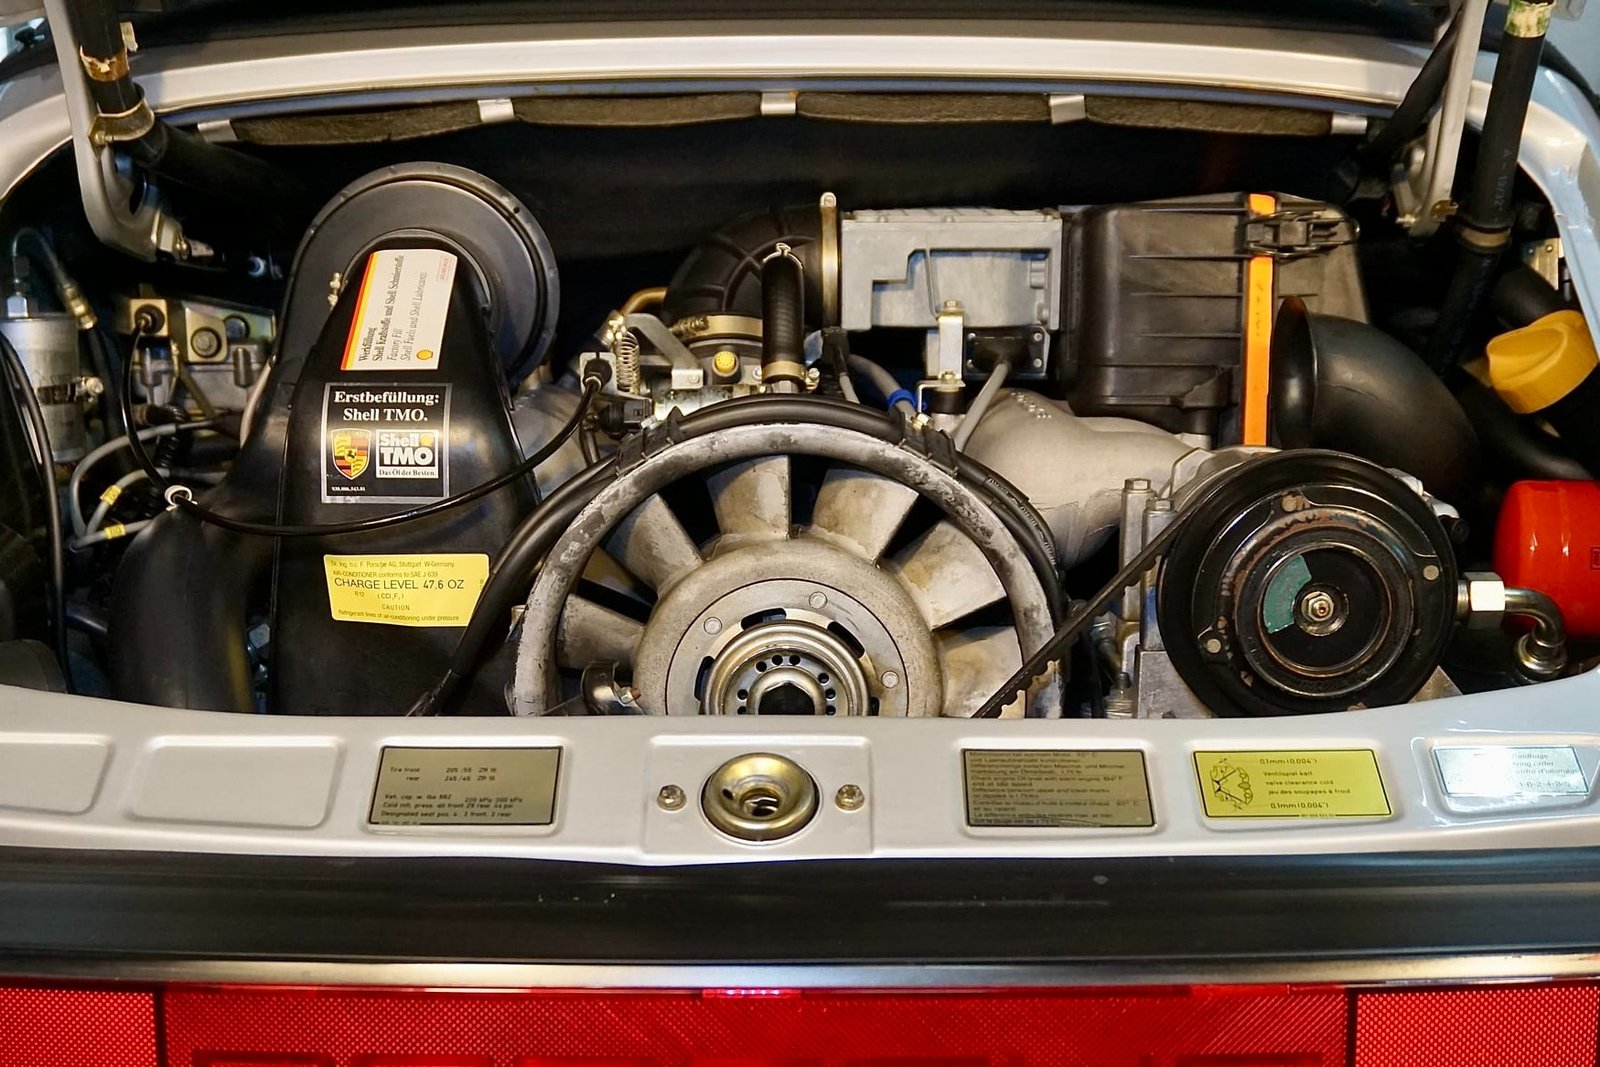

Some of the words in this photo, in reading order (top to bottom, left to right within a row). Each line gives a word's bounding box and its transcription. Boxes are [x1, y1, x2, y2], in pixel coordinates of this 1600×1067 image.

[385, 290, 397, 305] Shell
[385, 305, 394, 317] und
[410, 300, 422, 317] Shell
[410, 317, 419, 330] and
[392, 328, 403, 339] Fill
[403, 329, 417, 345] Fuels
[372, 344, 384, 361] Shell
[387, 338, 402, 361] Factory
[400, 344, 413, 361] Shell
[334, 390, 440, 406] Erstbefüllung:
[343, 408, 380, 421] Shell
[383, 408, 428, 422] TMO.
[379, 433, 420, 447] Shell
[379, 446, 434, 466] TMO
[401, 468, 412, 476] der
[412, 468, 437, 476] Besten.
[334, 577, 381, 589] CHARGE
[383, 579, 419, 590] LEVEL
[423, 579, 444, 590] 47.6
[447, 579, 465, 590] OZ
[381, 603, 410, 611] CAUTION
